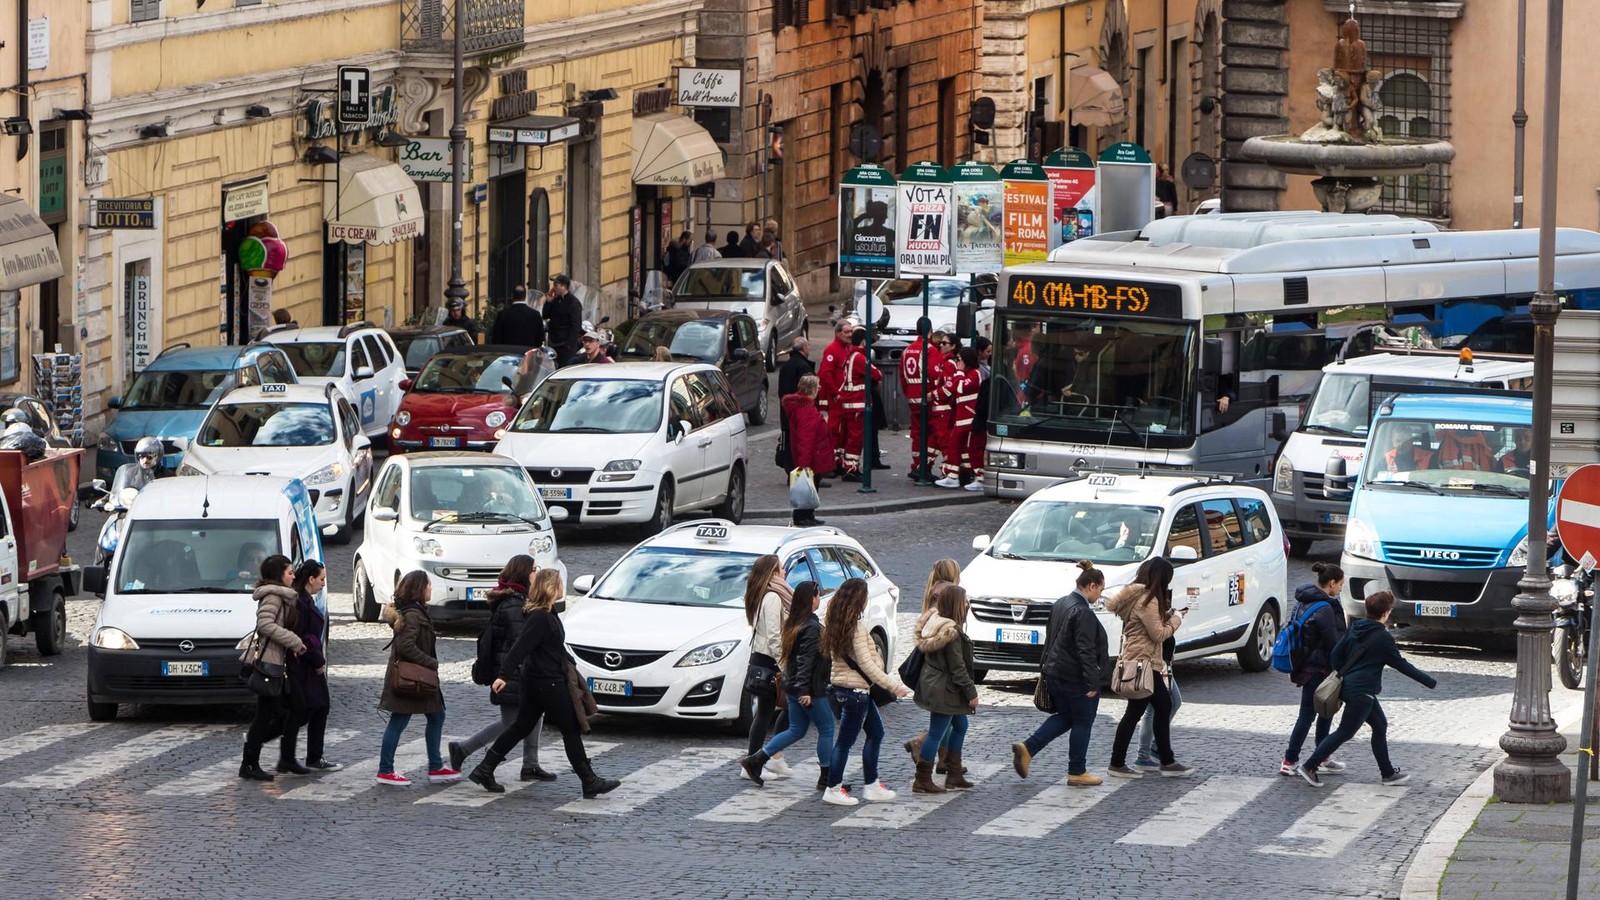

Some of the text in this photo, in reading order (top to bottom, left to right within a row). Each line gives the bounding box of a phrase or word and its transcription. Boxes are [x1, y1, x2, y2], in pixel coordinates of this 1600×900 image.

[692, 71, 723, 90] Caffè
[343, 71, 366, 105] T
[680, 89, 738, 103] Dell'Aracoeli
[401, 141, 442, 161] Bar
[43, 182, 59, 194] LOTTO
[906, 185, 947, 204] VOTA
[1004, 193, 1047, 205] FESTIVAL
[913, 204, 943, 212] FORZA
[98, 213, 140, 227] LOTTO
[1009, 212, 1042, 227] FILM
[331, 226, 377, 240] ICE CREAM
[392, 221, 417, 238] SNACK BAR
[910, 214, 942, 240] FN
[1018, 229, 1046, 240] ROMA
[908, 241, 939, 250] NUOVA
[1011, 242, 1023, 253] 17
[900, 254, 915, 265] ORA
[917, 254, 922, 265] O
[924, 254, 939, 266] MAI
[1012, 280, 1150, 312] 40 (MA-MB-FS)
[137, 280, 147, 342] BRUNCH
[262, 384, 285, 393] TAXI
[1069, 444, 1097, 455] 4463
[1090, 476, 1116, 486] TAXI
[699, 527, 726, 538] TAXI
[1420, 549, 1460, 560] IVECO
[1229, 575, 1239, 590] 35
[1229, 590, 1239, 605] 70
